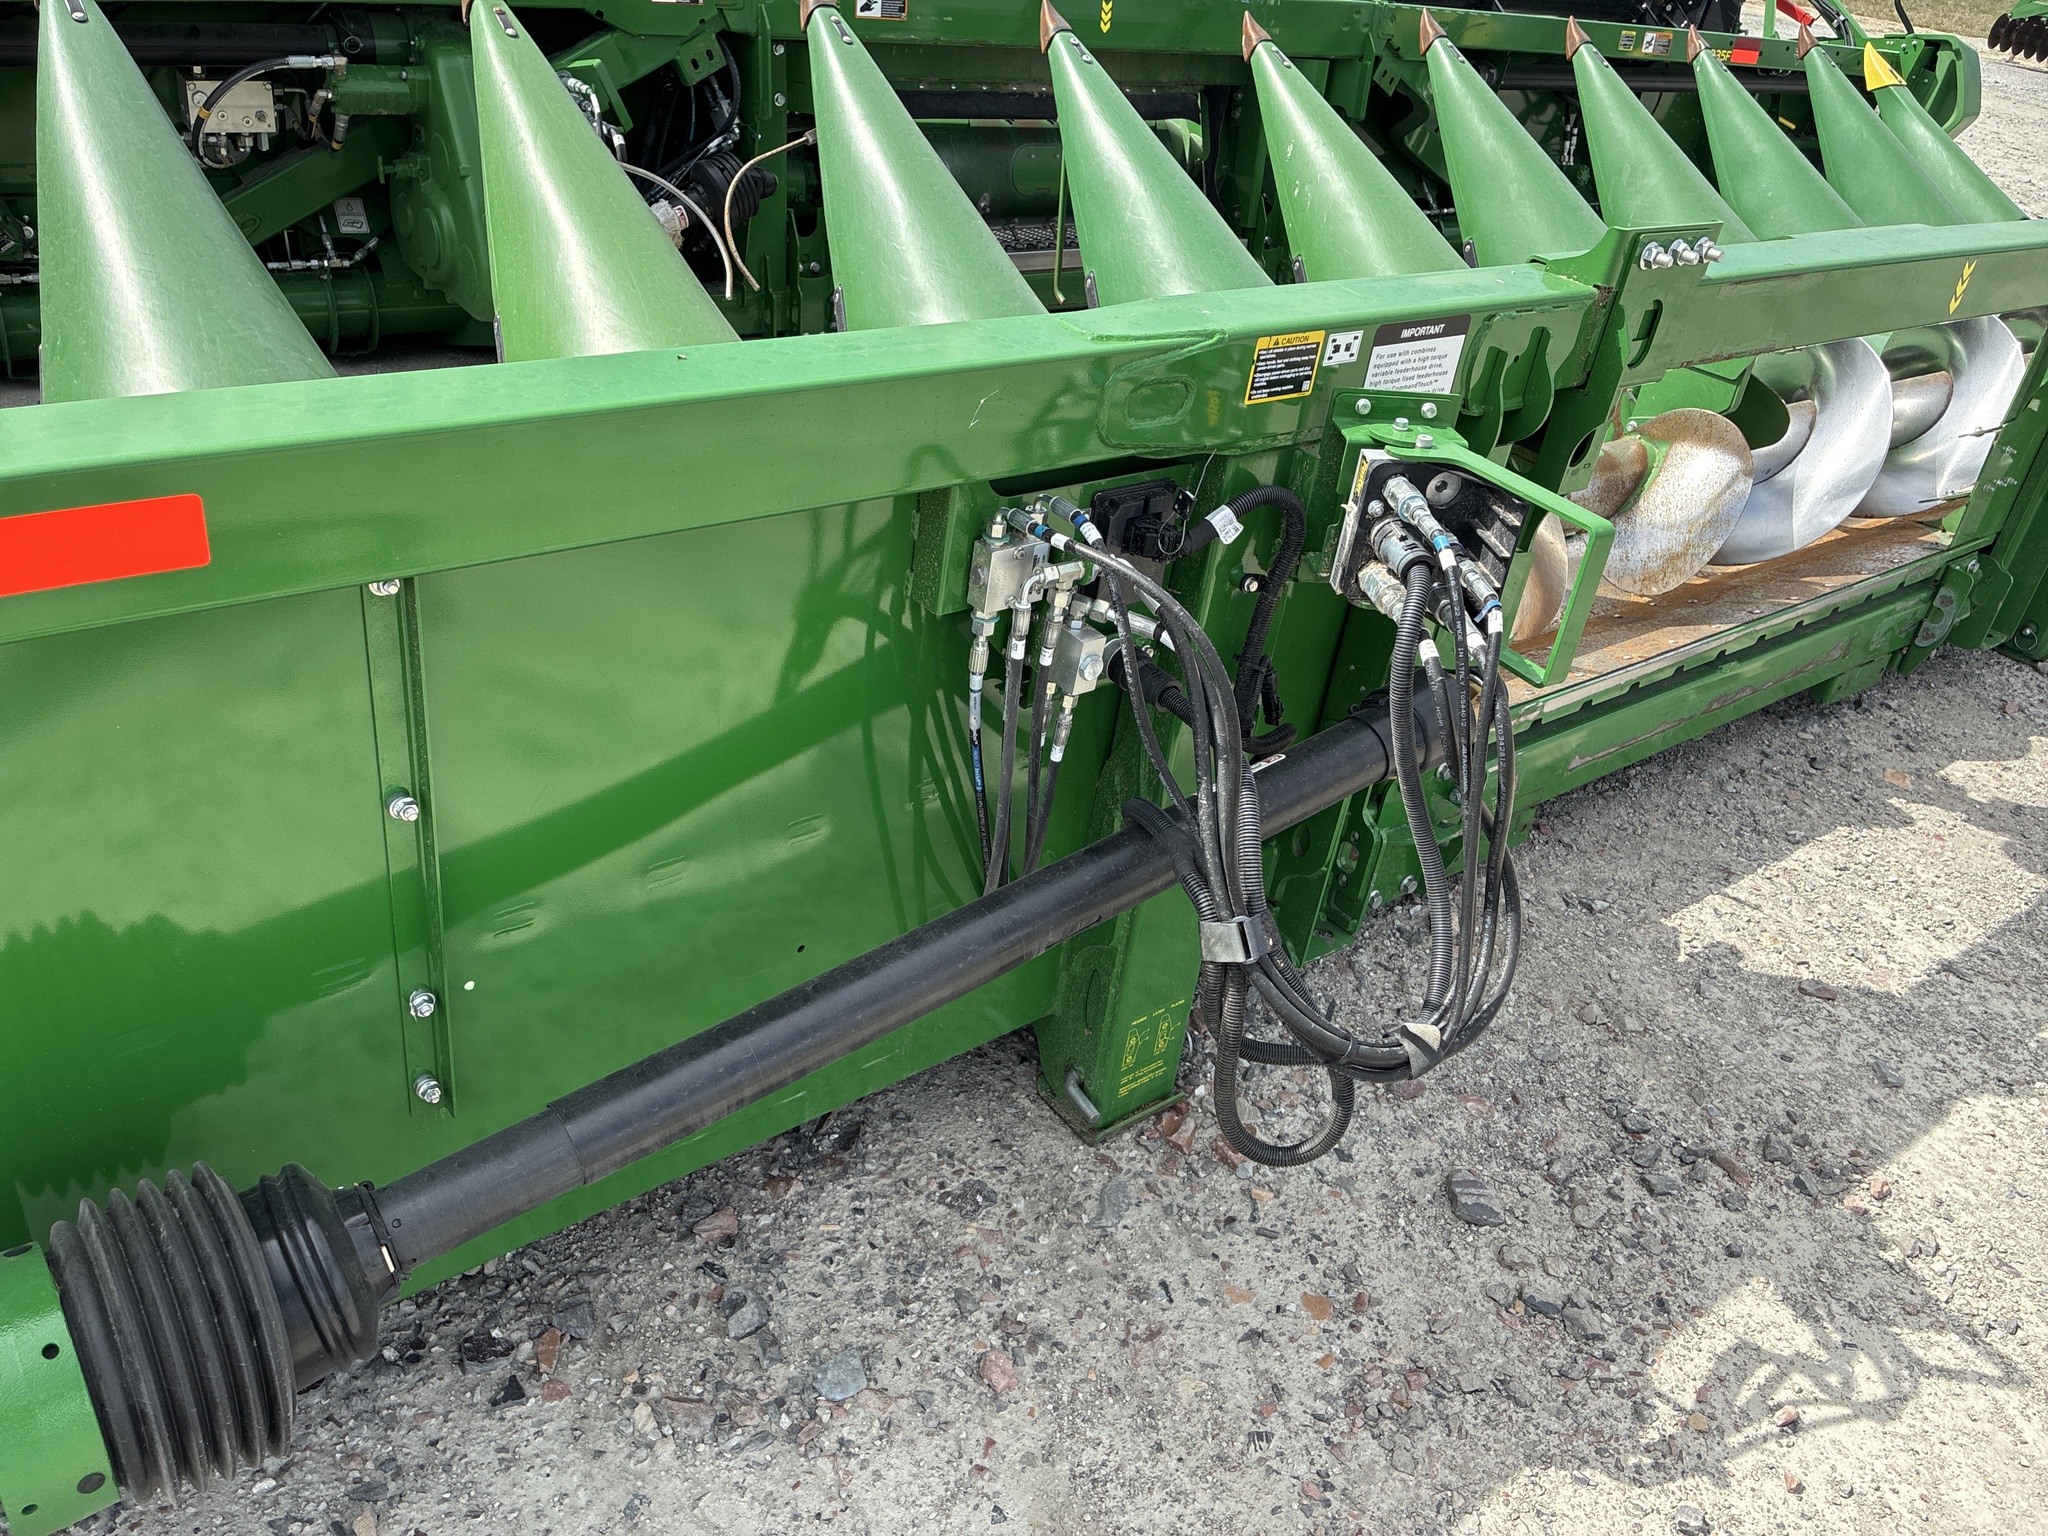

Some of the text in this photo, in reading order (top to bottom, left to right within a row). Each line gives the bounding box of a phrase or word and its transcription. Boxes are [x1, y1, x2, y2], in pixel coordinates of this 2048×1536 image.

[1400, 324, 1445, 338] IMPORTANT
[1281, 335, 1310, 345] CAUTION
[1411, 347, 1436, 355] combines
[1374, 360, 1399, 369] equipped
[1395, 365, 1427, 374] feederhouse
[1383, 377, 1401, 385] torque
[1416, 370, 1448, 380] feederhouse
[1454, 606, 1460, 616] 22
[1458, 647, 1464, 658] IN
